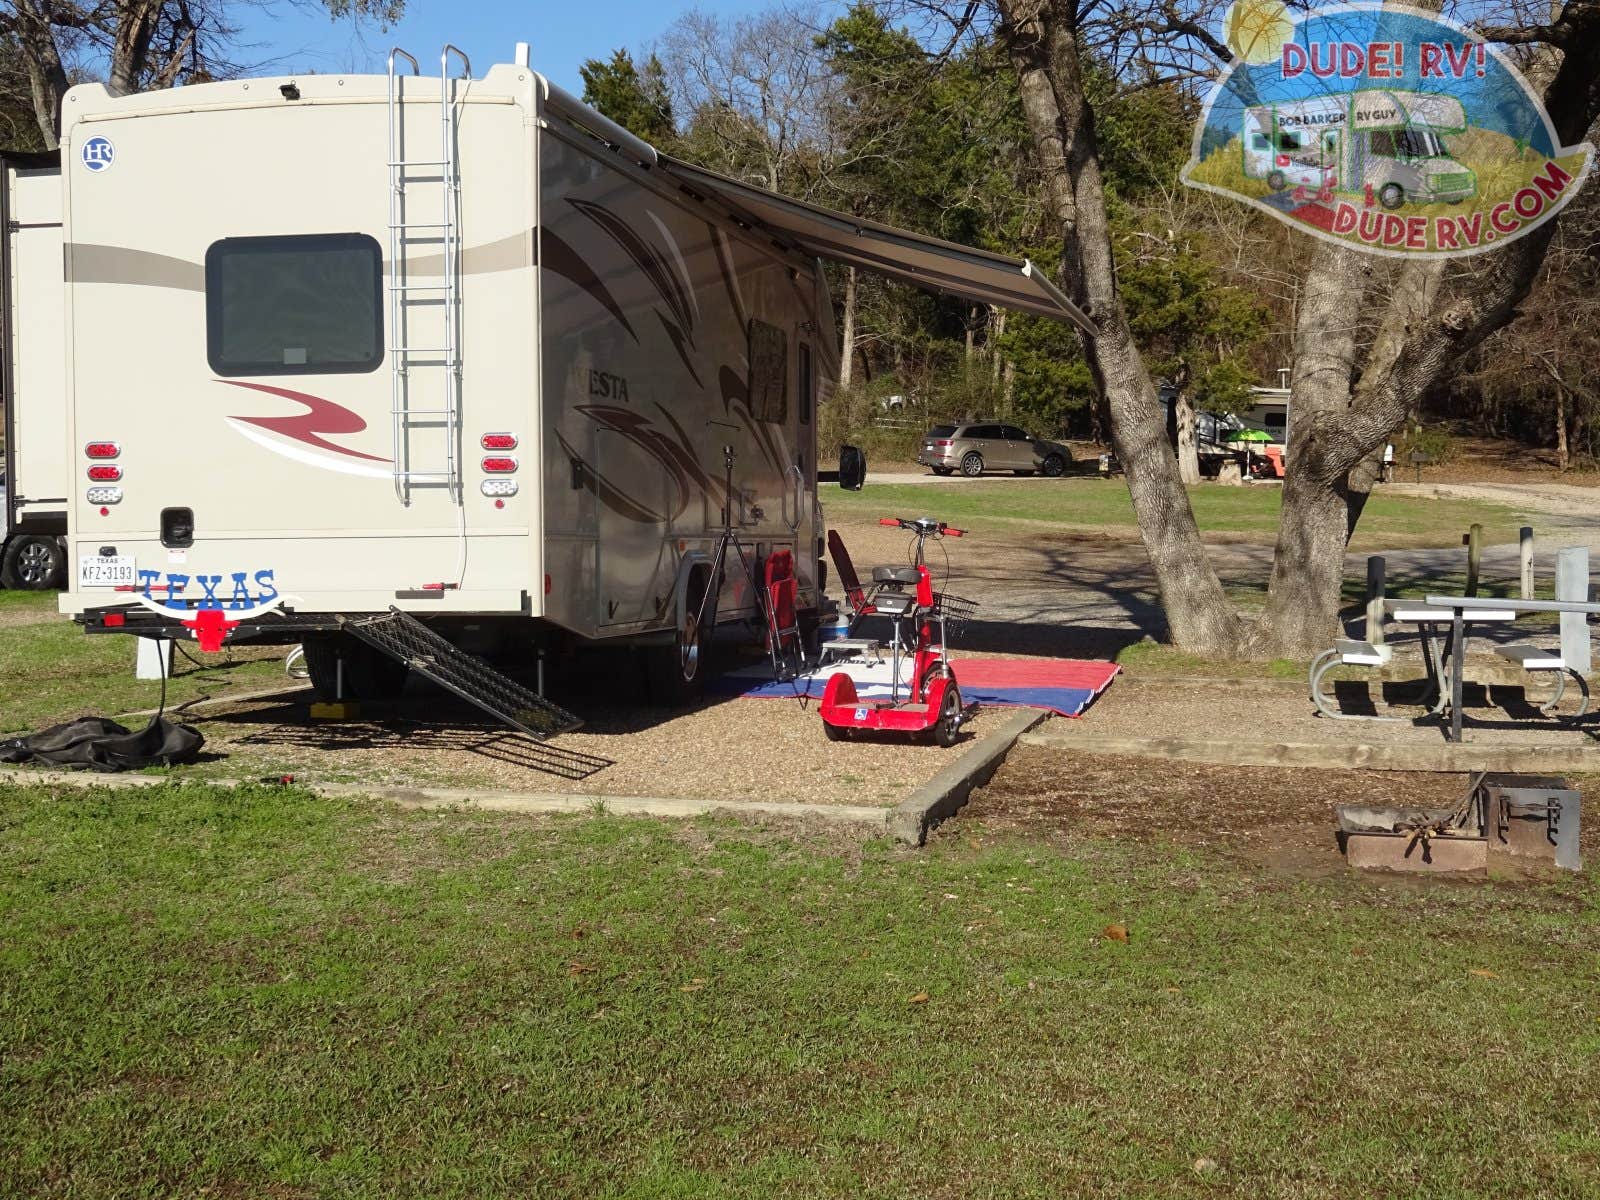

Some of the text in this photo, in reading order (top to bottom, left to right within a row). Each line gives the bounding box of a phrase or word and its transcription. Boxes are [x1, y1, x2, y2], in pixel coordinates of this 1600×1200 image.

[86, 143, 113, 161] HR
[578, 367, 629, 402] ESTA
[138, 569, 280, 610] TEXAS
